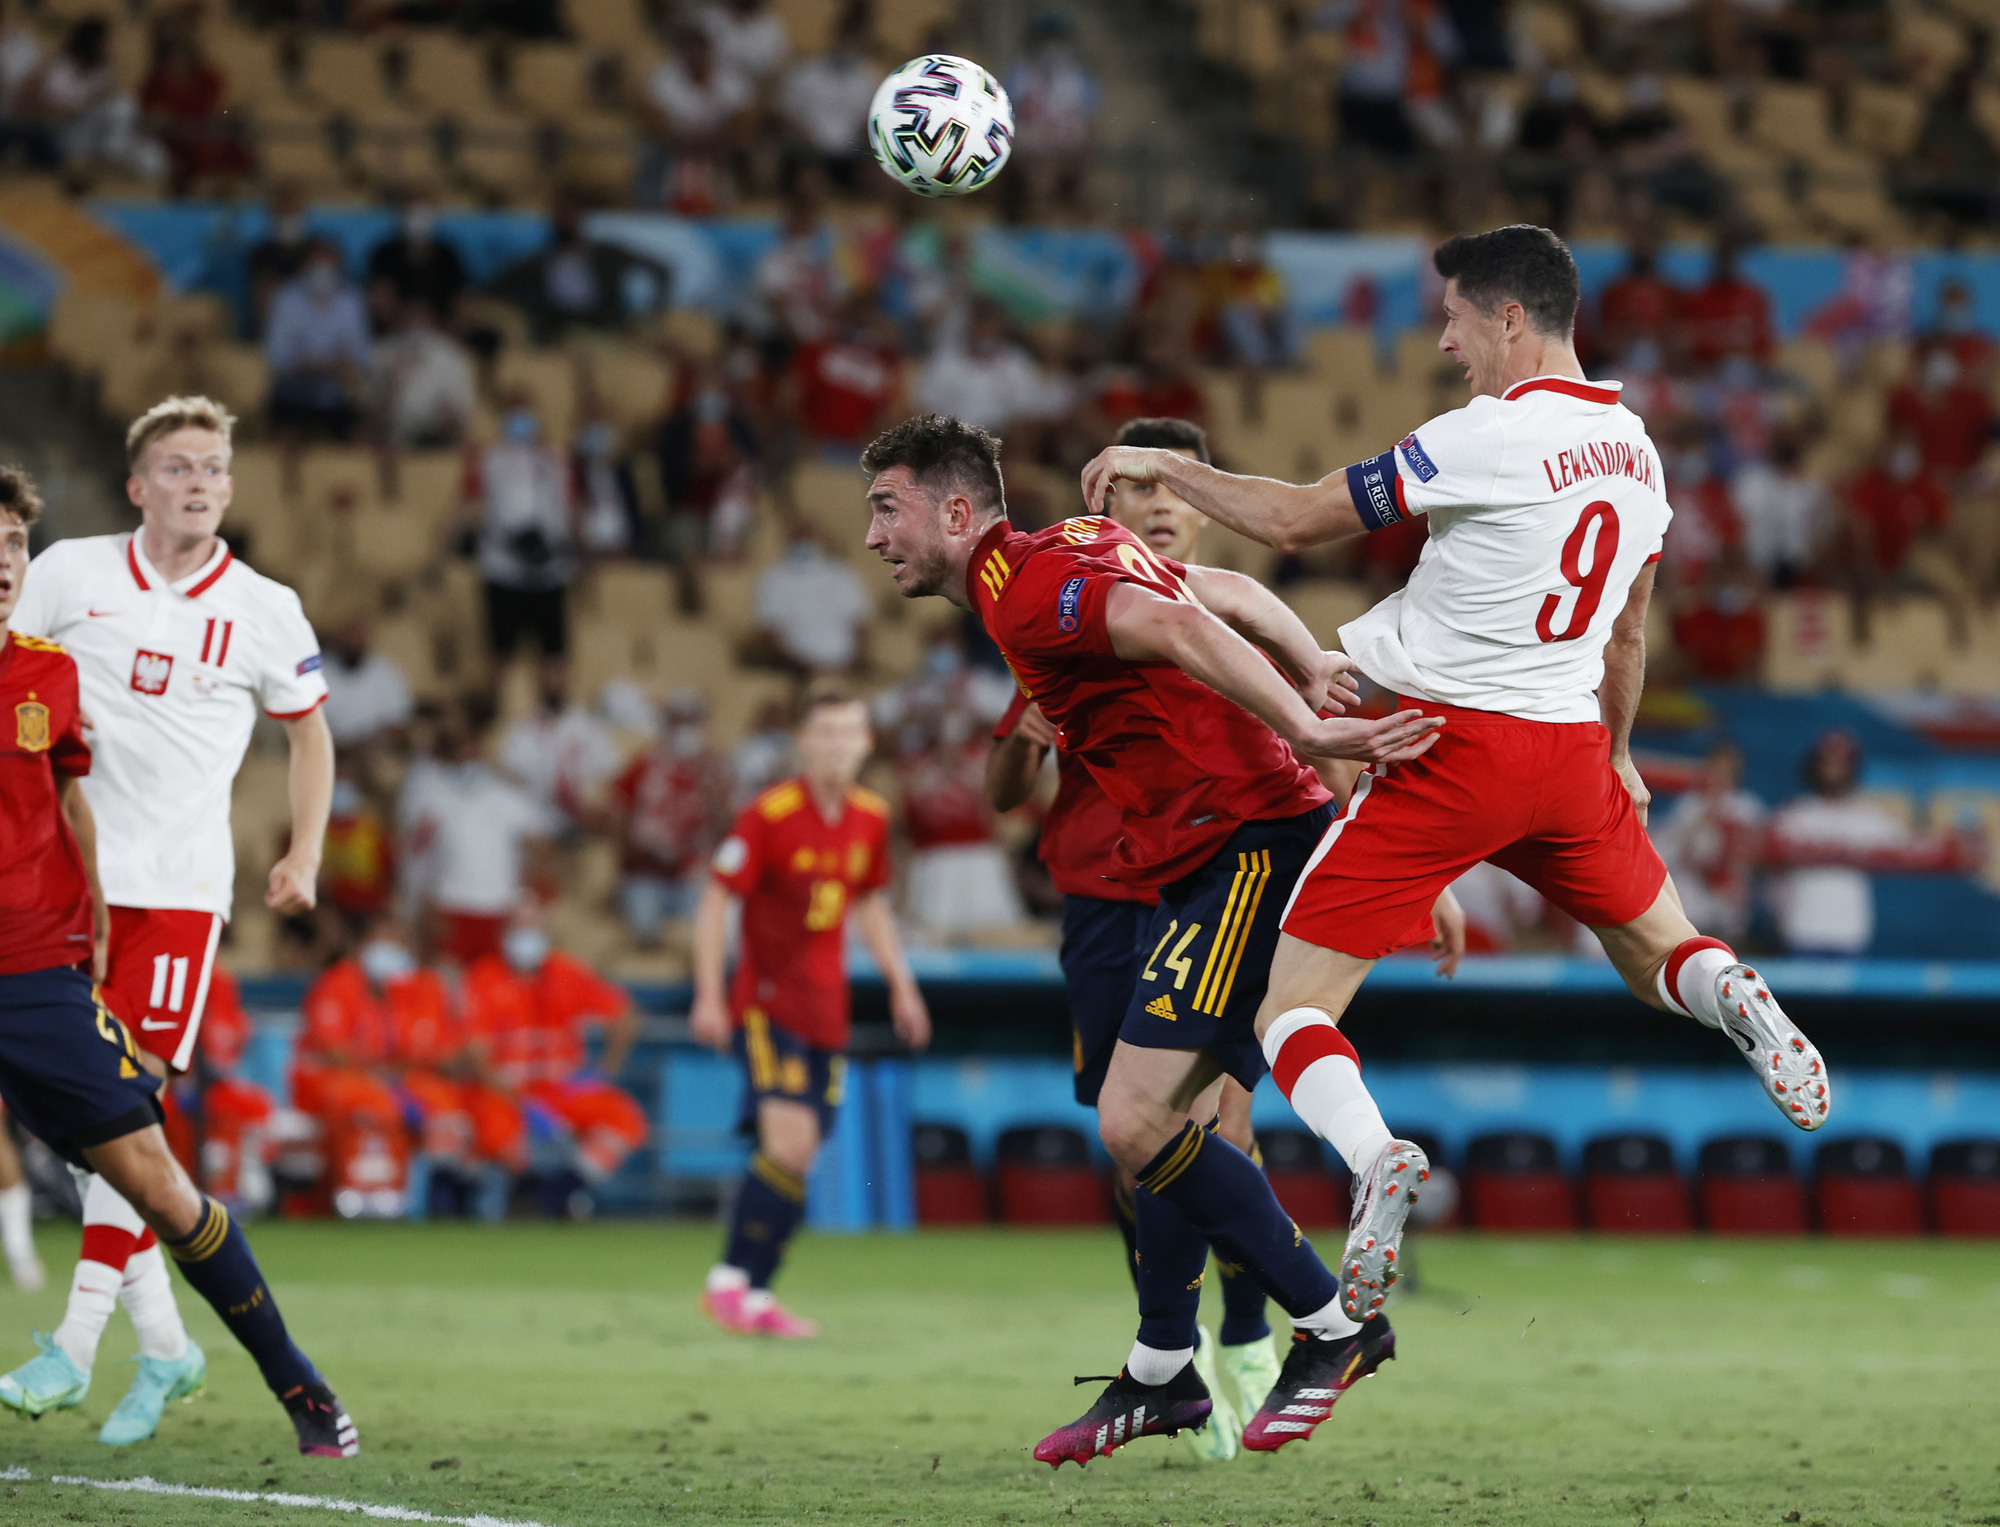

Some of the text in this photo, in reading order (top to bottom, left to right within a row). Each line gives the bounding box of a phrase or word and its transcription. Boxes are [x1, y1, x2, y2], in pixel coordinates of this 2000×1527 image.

[1406, 445, 1435, 479] RESPECT
[1543, 441, 1656, 493] LEWANDOWSKI
[1370, 485, 1400, 526] RESPEC
[1063, 578, 1082, 615] RESPECT
[1535, 500, 1620, 643] 9
[200, 618, 232, 668] 11
[1141, 919, 1202, 991] 24
[149, 952, 189, 1013] 11
[1144, 1003, 1178, 1022] adidas
